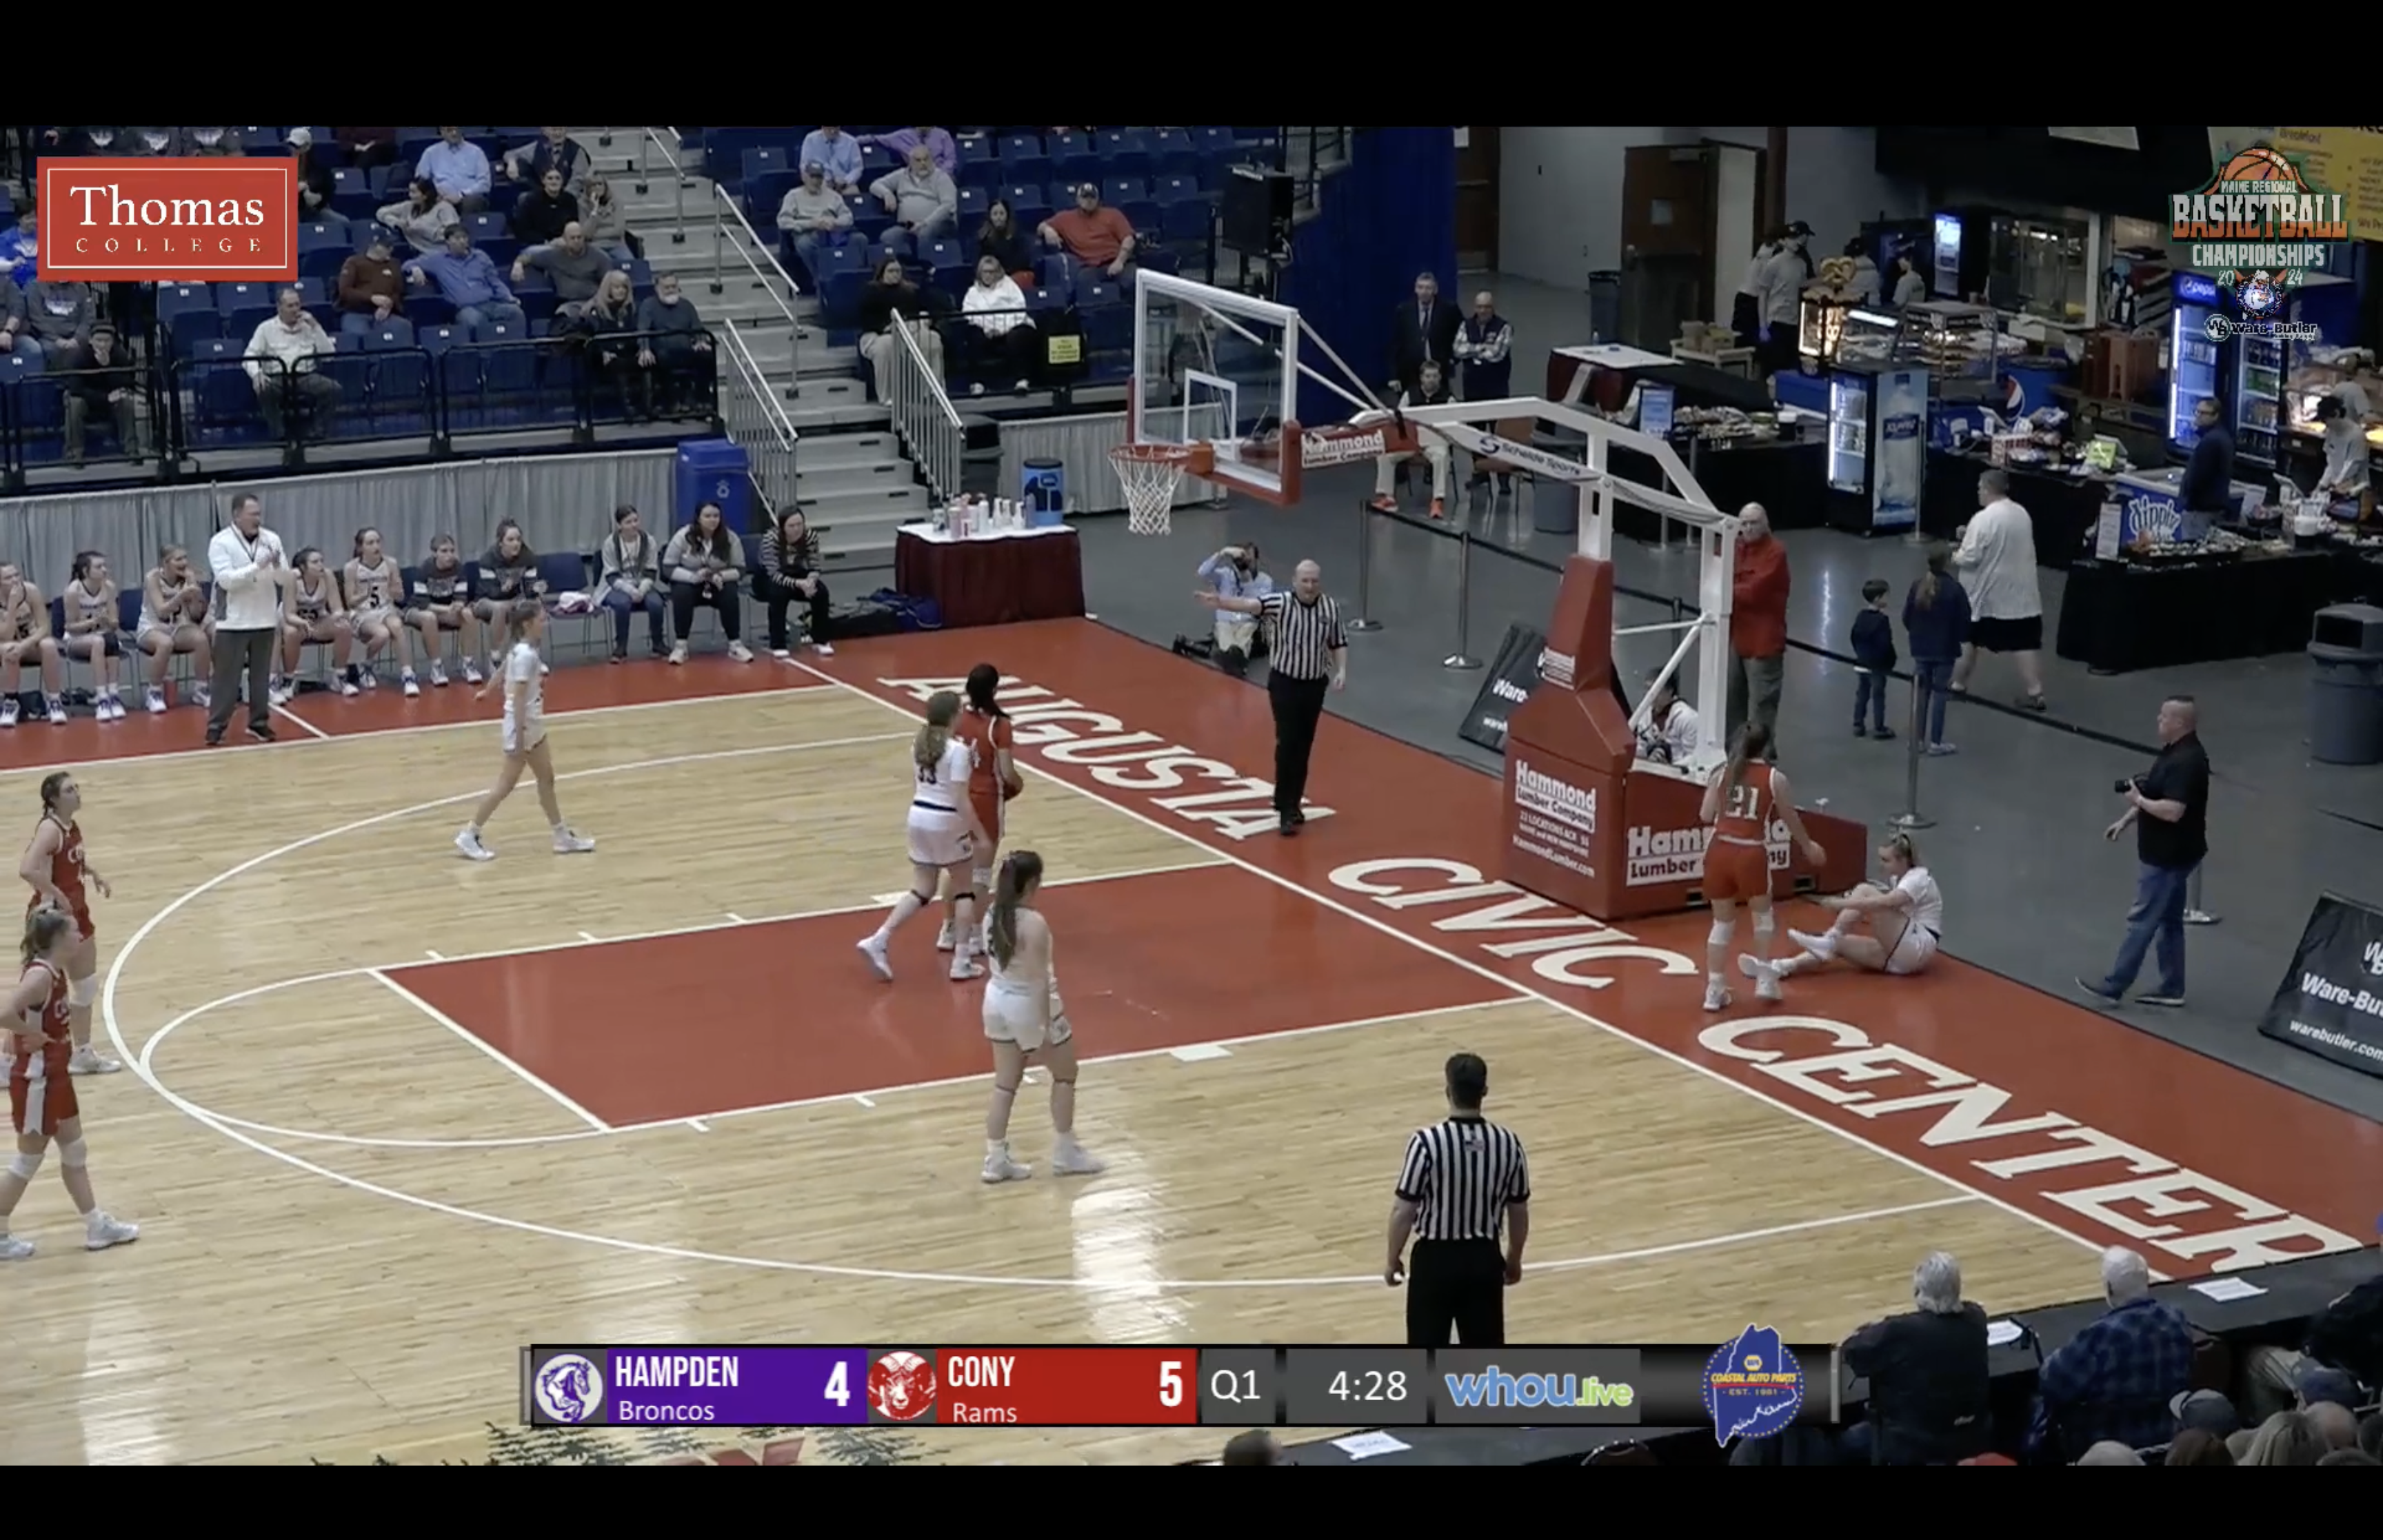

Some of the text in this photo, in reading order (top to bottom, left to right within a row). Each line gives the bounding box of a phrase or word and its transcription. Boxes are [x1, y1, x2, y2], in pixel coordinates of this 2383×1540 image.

[1547, 456, 1580, 475] Sports
[1516, 760, 1596, 811] Hammond
[1726, 786, 1759, 819] 21
[1518, 787, 1593, 831] Lumber Company
[1631, 858, 1696, 878] Lumber
[1328, 858, 1699, 989] CIVIC
[1698, 1015, 2364, 1273] CENTER
